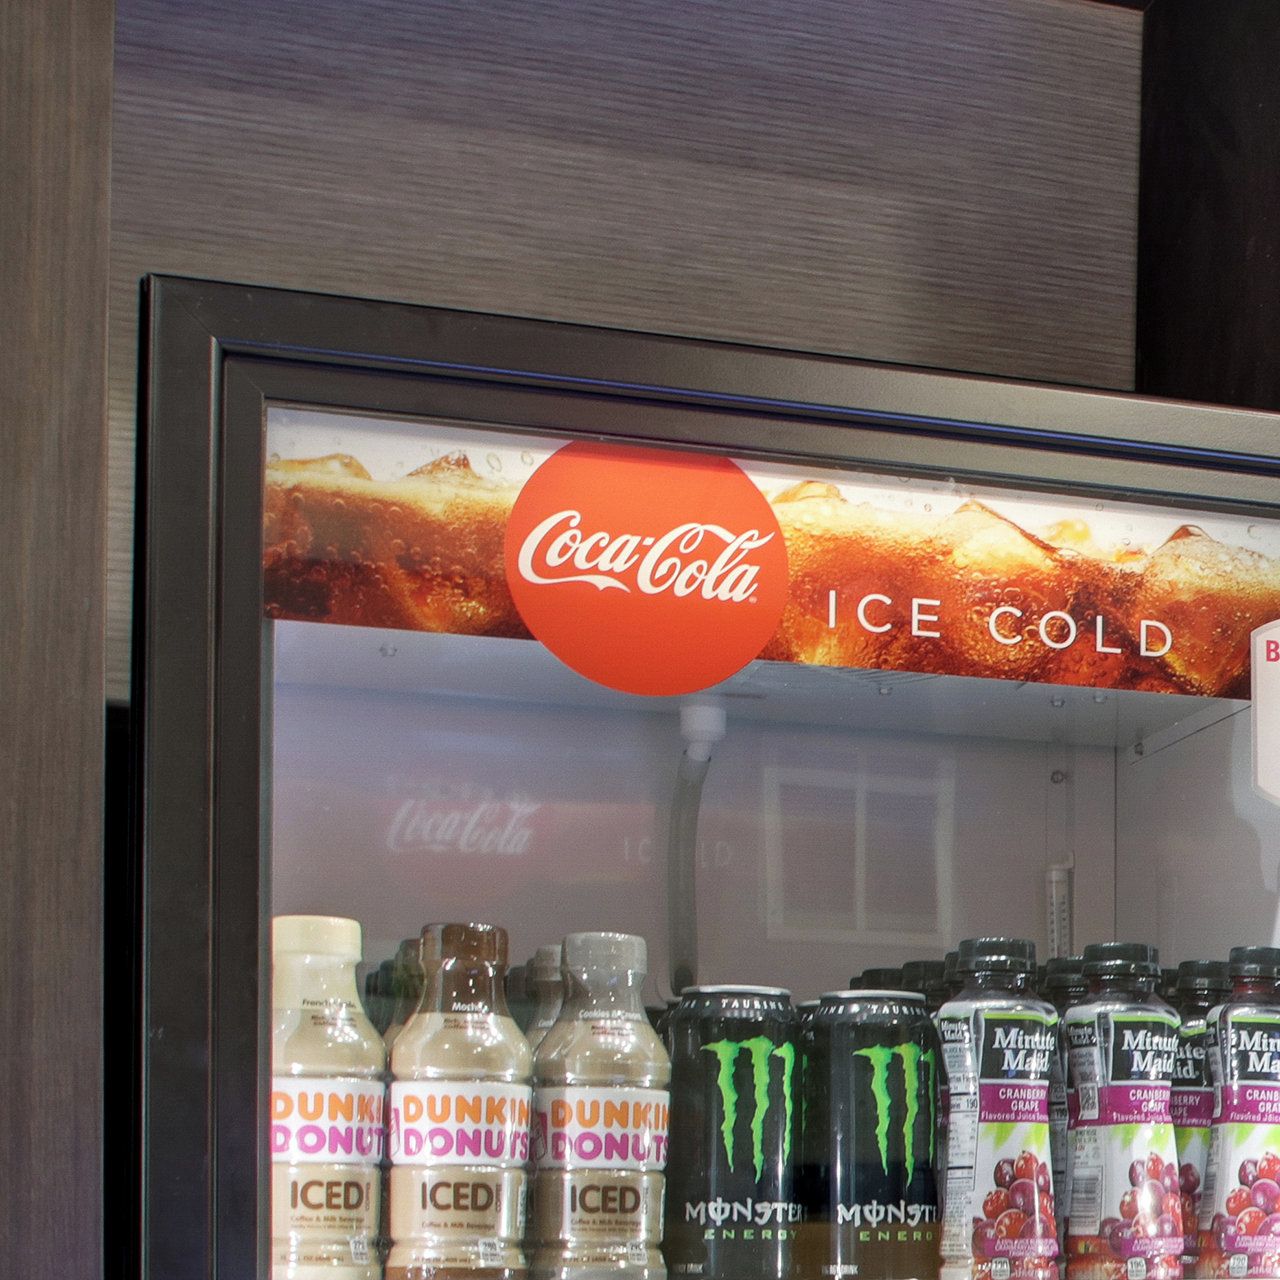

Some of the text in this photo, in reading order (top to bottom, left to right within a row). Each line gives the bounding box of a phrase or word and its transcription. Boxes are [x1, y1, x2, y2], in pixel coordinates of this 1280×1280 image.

[518, 509, 775, 602] Coca-Cola
[827, 589, 1174, 657] ICE COLD
[991, 1027, 1056, 1051] Minute
[1001, 1049, 1050, 1072] Maid
[1131, 1050, 1175, 1073] Maid
[981, 1110, 1016, 1120] Flavored
[1010, 1101, 1040, 1111] GRAPE
[1230, 1111, 1261, 1122] Flavored
[403, 1127, 530, 1161] DONUTS
[290, 1180, 364, 1211] ICED
[421, 1181, 495, 1212] ICED
[570, 1184, 641, 1214] ICED
[704, 1229, 798, 1241] ENERGY
